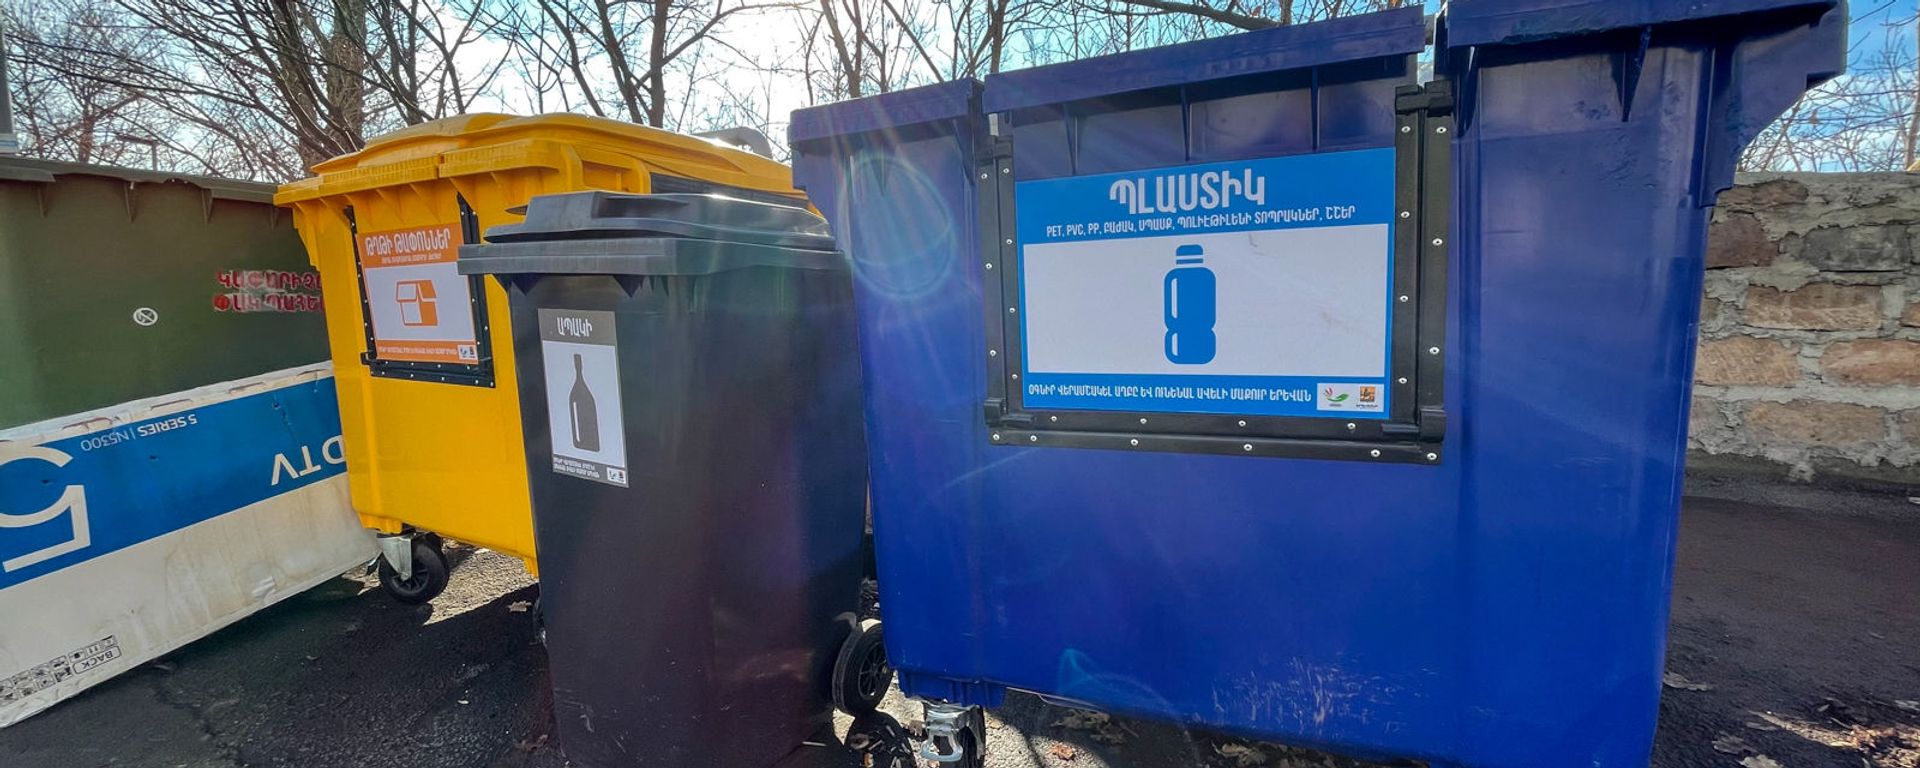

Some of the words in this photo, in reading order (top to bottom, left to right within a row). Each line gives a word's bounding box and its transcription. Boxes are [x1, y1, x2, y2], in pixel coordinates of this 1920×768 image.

[1109, 168, 1265, 215] ՊԼԱՍՏԻԿ
[1325, 205, 1356, 220] ՇՇԵՐ
[365, 235, 392, 256] ԹՂԹԻ
[393, 228, 451, 254] ԹԱՓՈՆՆԵՐ
[556, 316, 593, 337] ԱՊԱԿԻ
[1028, 384, 1055, 396] ՕԳՆԻՐ
[1057, 384, 1113, 397] ՎԵՐԱՄՇԱԿԵԼ
[1114, 385, 1138, 398] ԱՂԲԸ
[1140, 386, 1153, 398] ԵՎ
[1154, 386, 1194, 399] ՈՒՆԵՆԱԼ
[1197, 387, 1228, 400] ԱՎԵԼԻ
[1230, 388, 1267, 401] ՄԱՔՈՒՐ
[1269, 388, 1312, 402] ԵՐԵՎԱՆ
[136, 417, 187, 437] SERIES
[187, 414, 198, 425] 5
[80, 431, 130, 451] N5300
[0, 446, 91, 573] 5
[81, 650, 113, 670] BACK
